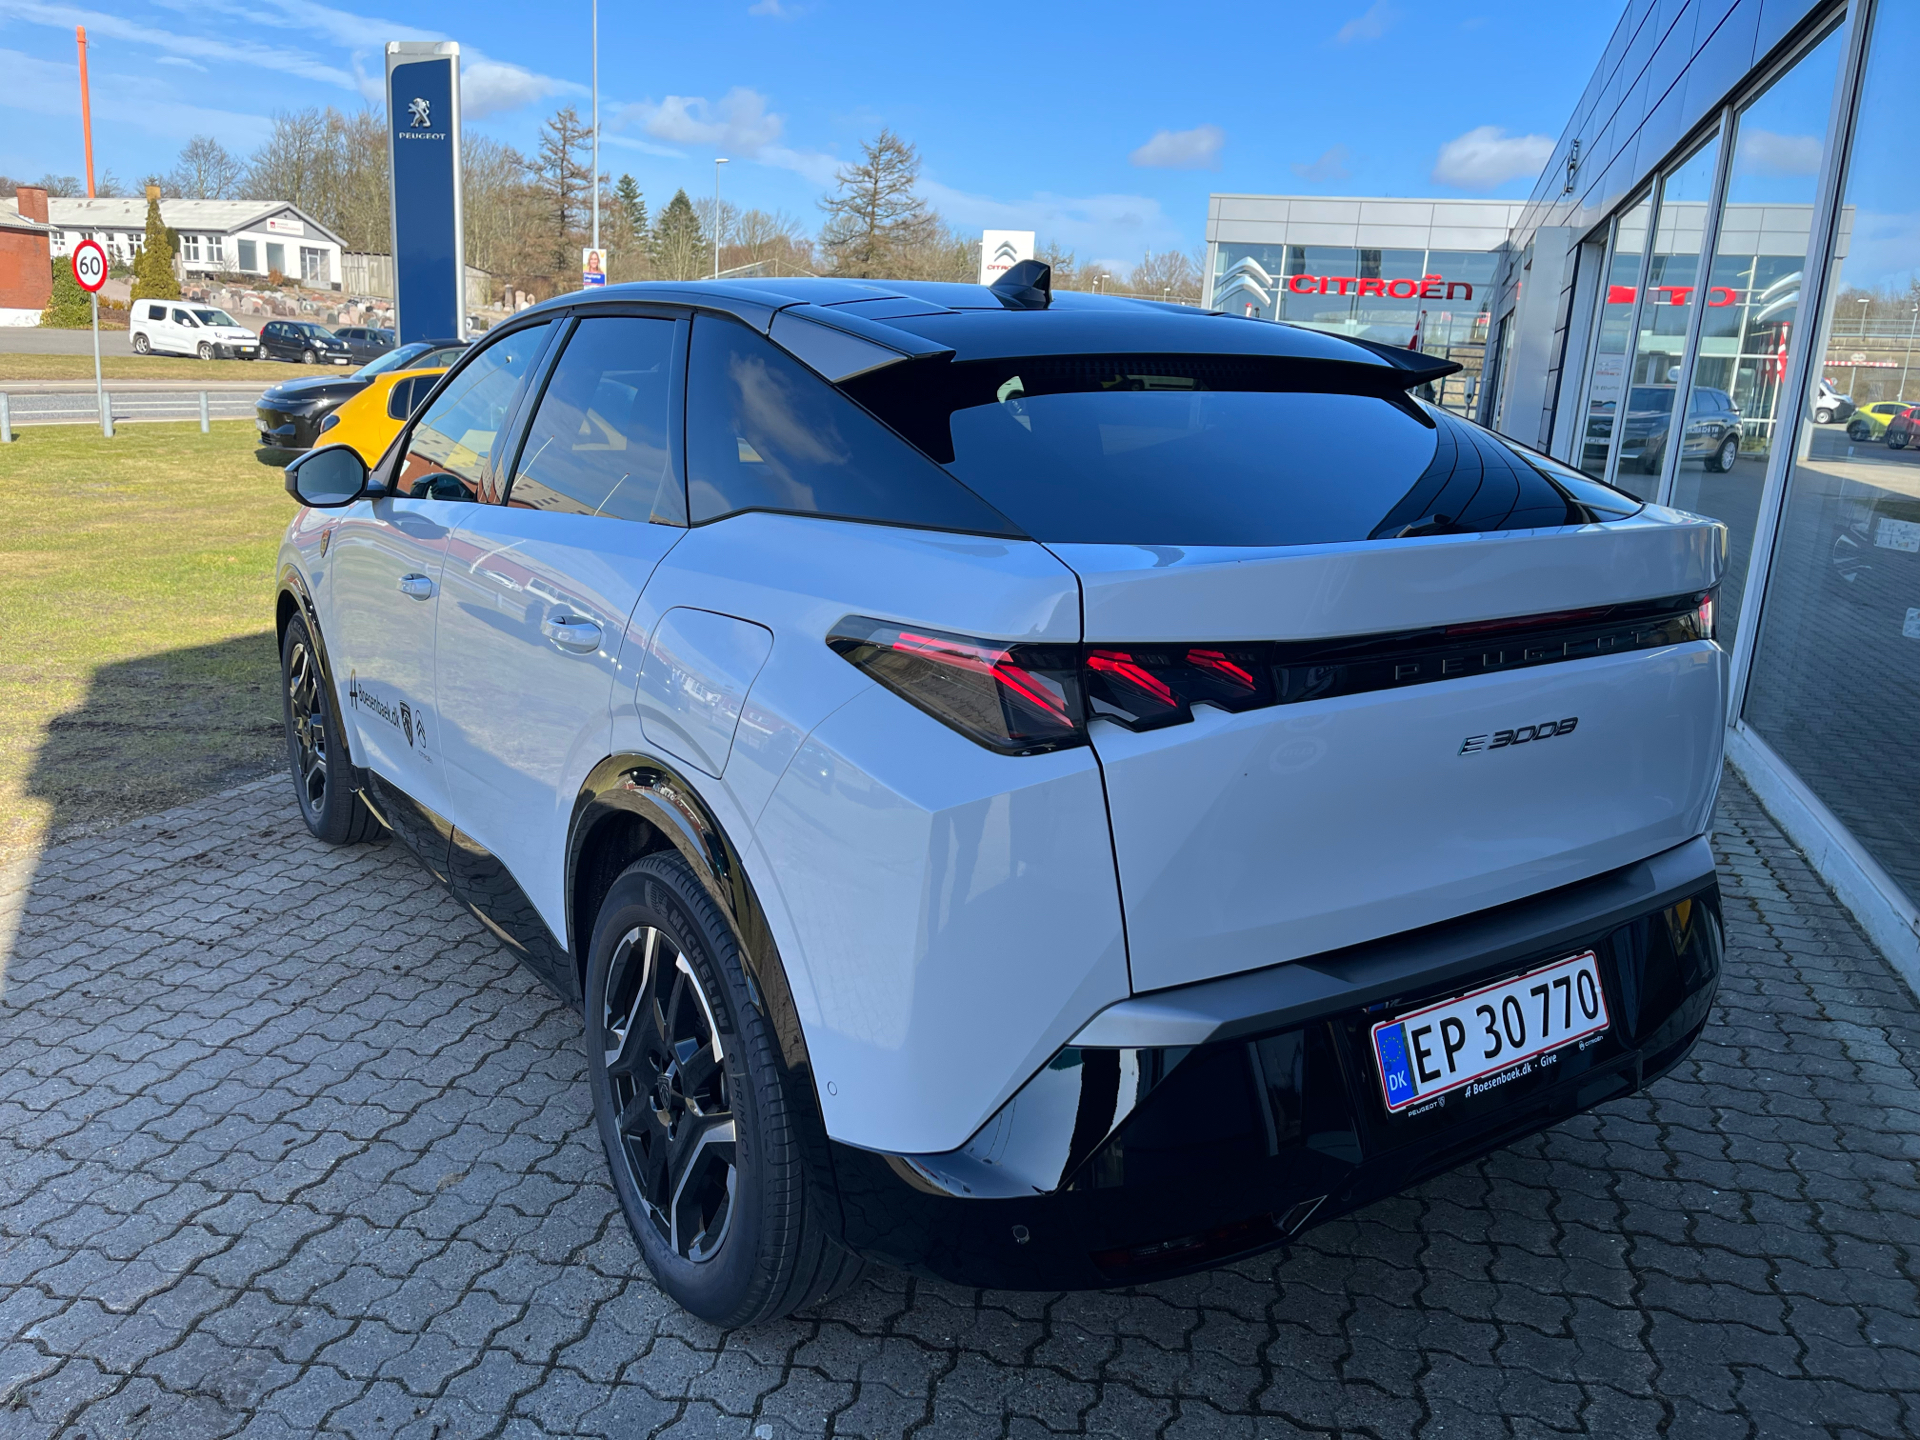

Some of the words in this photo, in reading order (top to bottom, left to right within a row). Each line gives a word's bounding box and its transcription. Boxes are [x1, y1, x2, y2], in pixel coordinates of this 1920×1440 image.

[398, 132, 446, 140] PEUGEOT
[79, 256, 100, 275] 60
[1395, 631, 1639, 680] PEUGEOT
[1457, 734, 1488, 756] E
[1487, 716, 1579, 750] 3008
[669, 908, 728, 1028] MICHELIN
[1410, 1016, 1466, 1084] EP
[1475, 994, 1526, 1059] 30
[1530, 969, 1599, 1038] 770
[1389, 1070, 1408, 1091] DK
[1473, 1062, 1532, 1095] Boesenbaek.dk
[1540, 1054, 1557, 1067] Give
[1408, 1101, 1438, 1118] PEUGEOT
